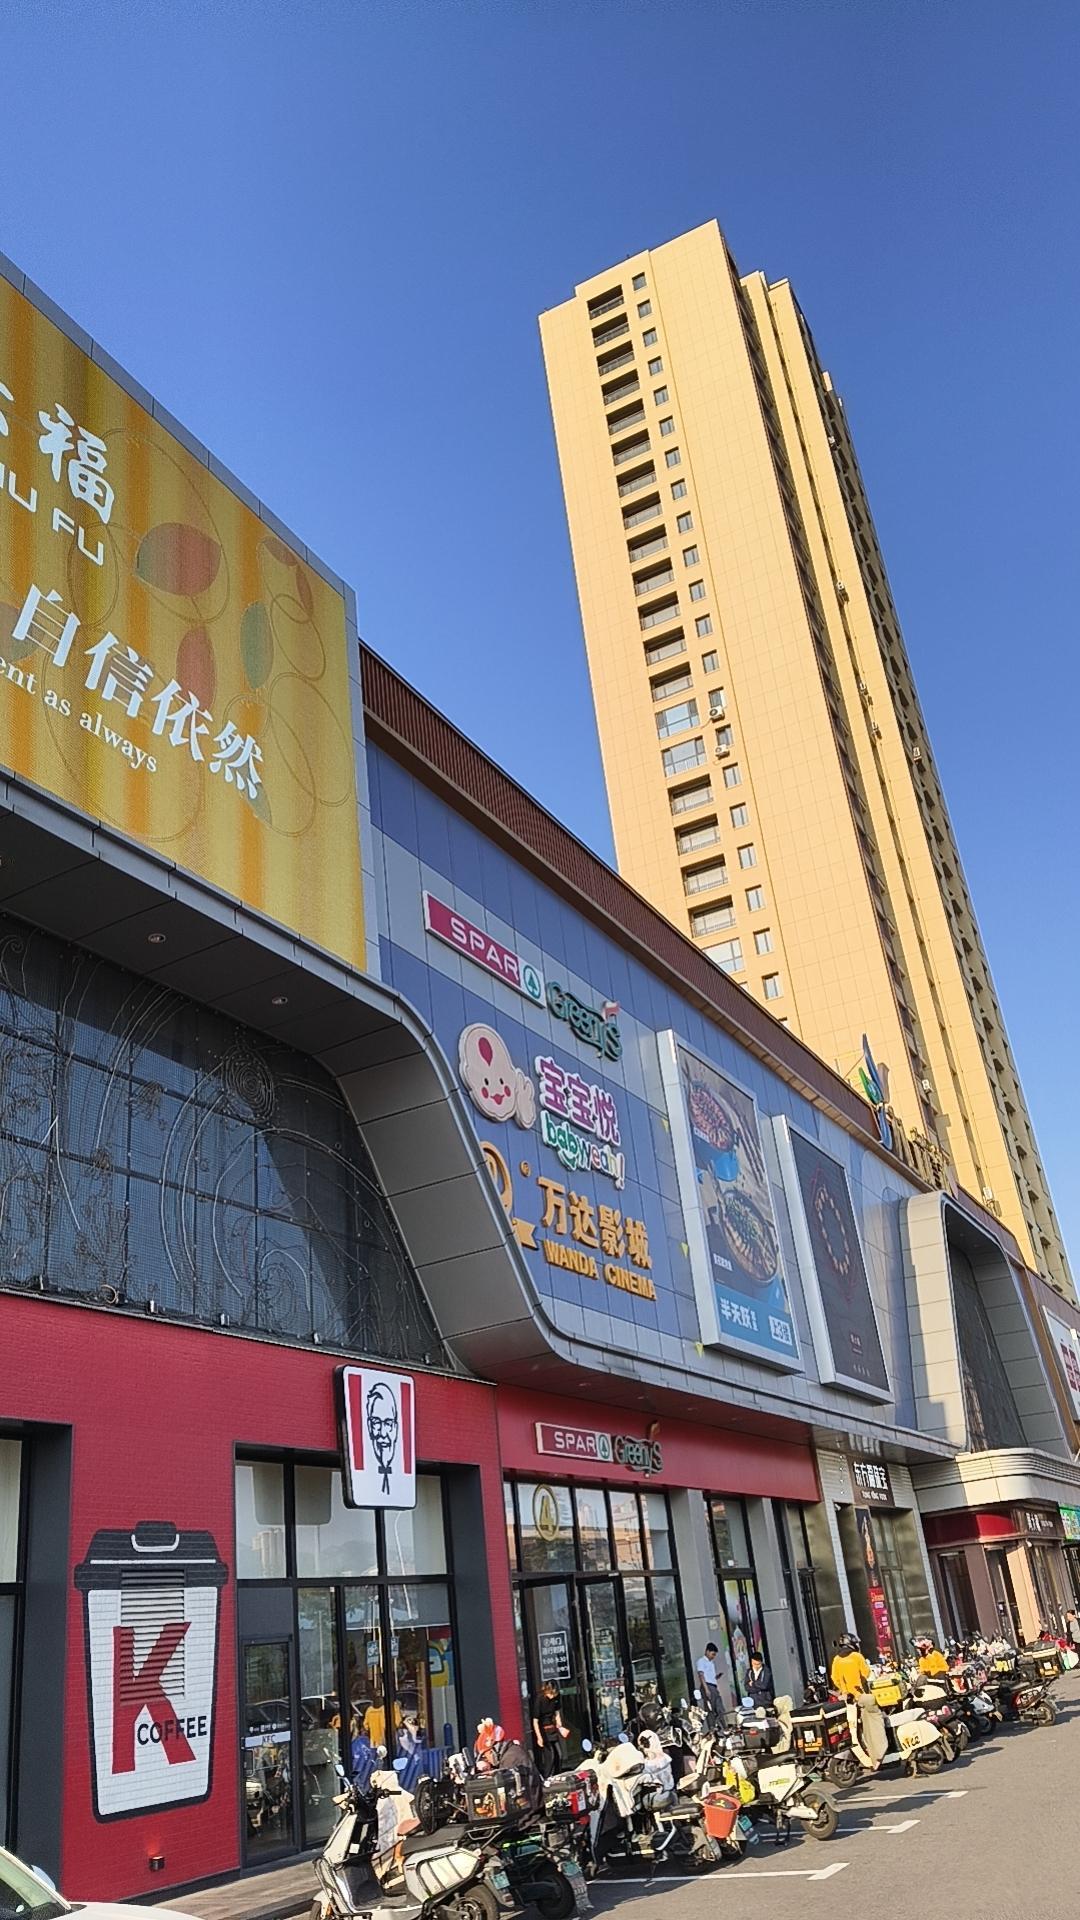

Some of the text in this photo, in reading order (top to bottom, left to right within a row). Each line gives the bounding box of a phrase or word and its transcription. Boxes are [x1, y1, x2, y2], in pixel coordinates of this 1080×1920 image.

[53, 507, 104, 567] FU
[12, 583, 265, 800] 自信依然
[44, 689, 71, 717] as
[79, 711, 157, 773] always
[450, 917, 520, 981] SPAR
[536, 1056, 621, 1147] 宝宝悦
[537, 1176, 652, 1270] 万达影城
[543, 1239, 657, 1301] WANDA CINEMA
[554, 1431, 597, 1453] SPAR
[137, 1715, 207, 1746] COFFEE
